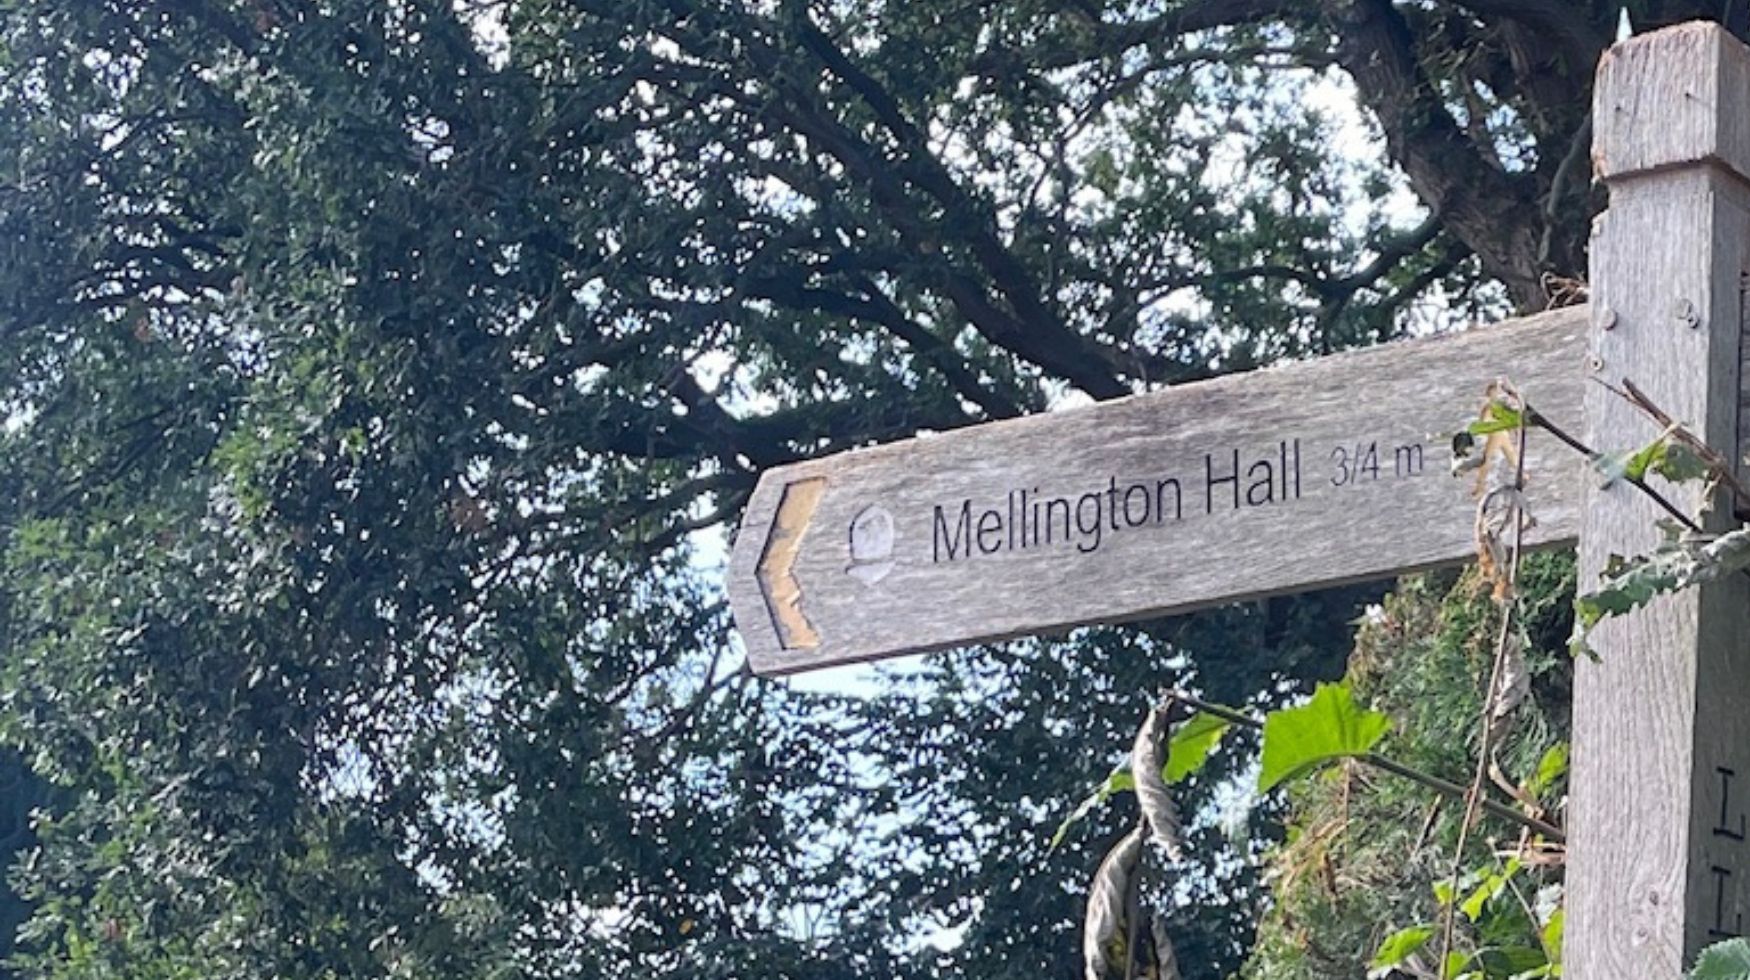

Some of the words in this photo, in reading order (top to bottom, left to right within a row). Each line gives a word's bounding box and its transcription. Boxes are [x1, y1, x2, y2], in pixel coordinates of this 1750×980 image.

[932, 476, 1181, 564] Mellington
[1205, 439, 1303, 514] Hall
[1329, 440, 1381, 488] 3/4
[1395, 443, 1424, 477] m
